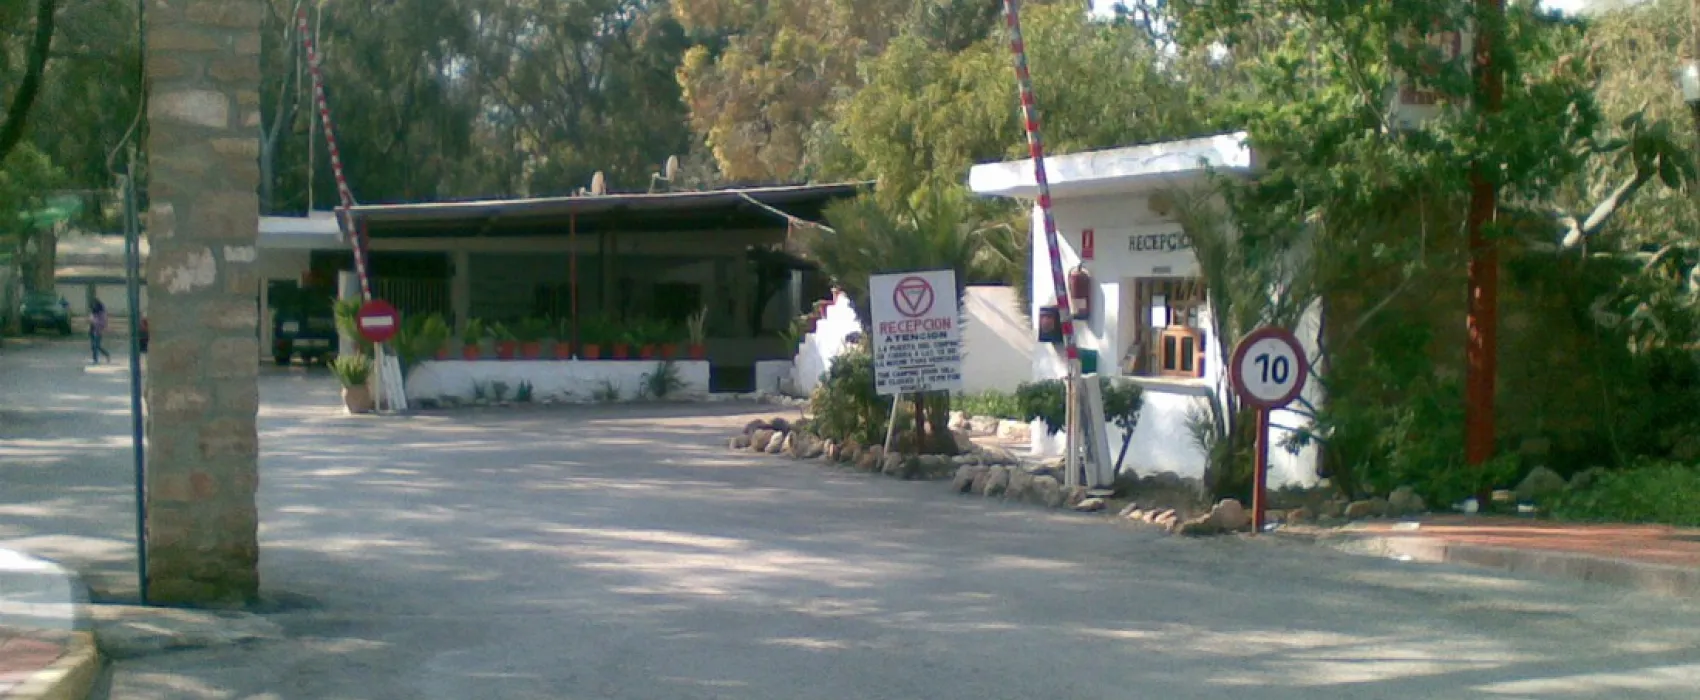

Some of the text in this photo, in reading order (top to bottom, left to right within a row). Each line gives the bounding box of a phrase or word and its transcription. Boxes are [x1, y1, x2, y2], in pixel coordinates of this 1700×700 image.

[1128, 233, 1192, 252] RECEPCIO
[879, 318, 951, 335] RECEPCION
[886, 332, 947, 341] ATENCION
[1254, 353, 1289, 384] 10
